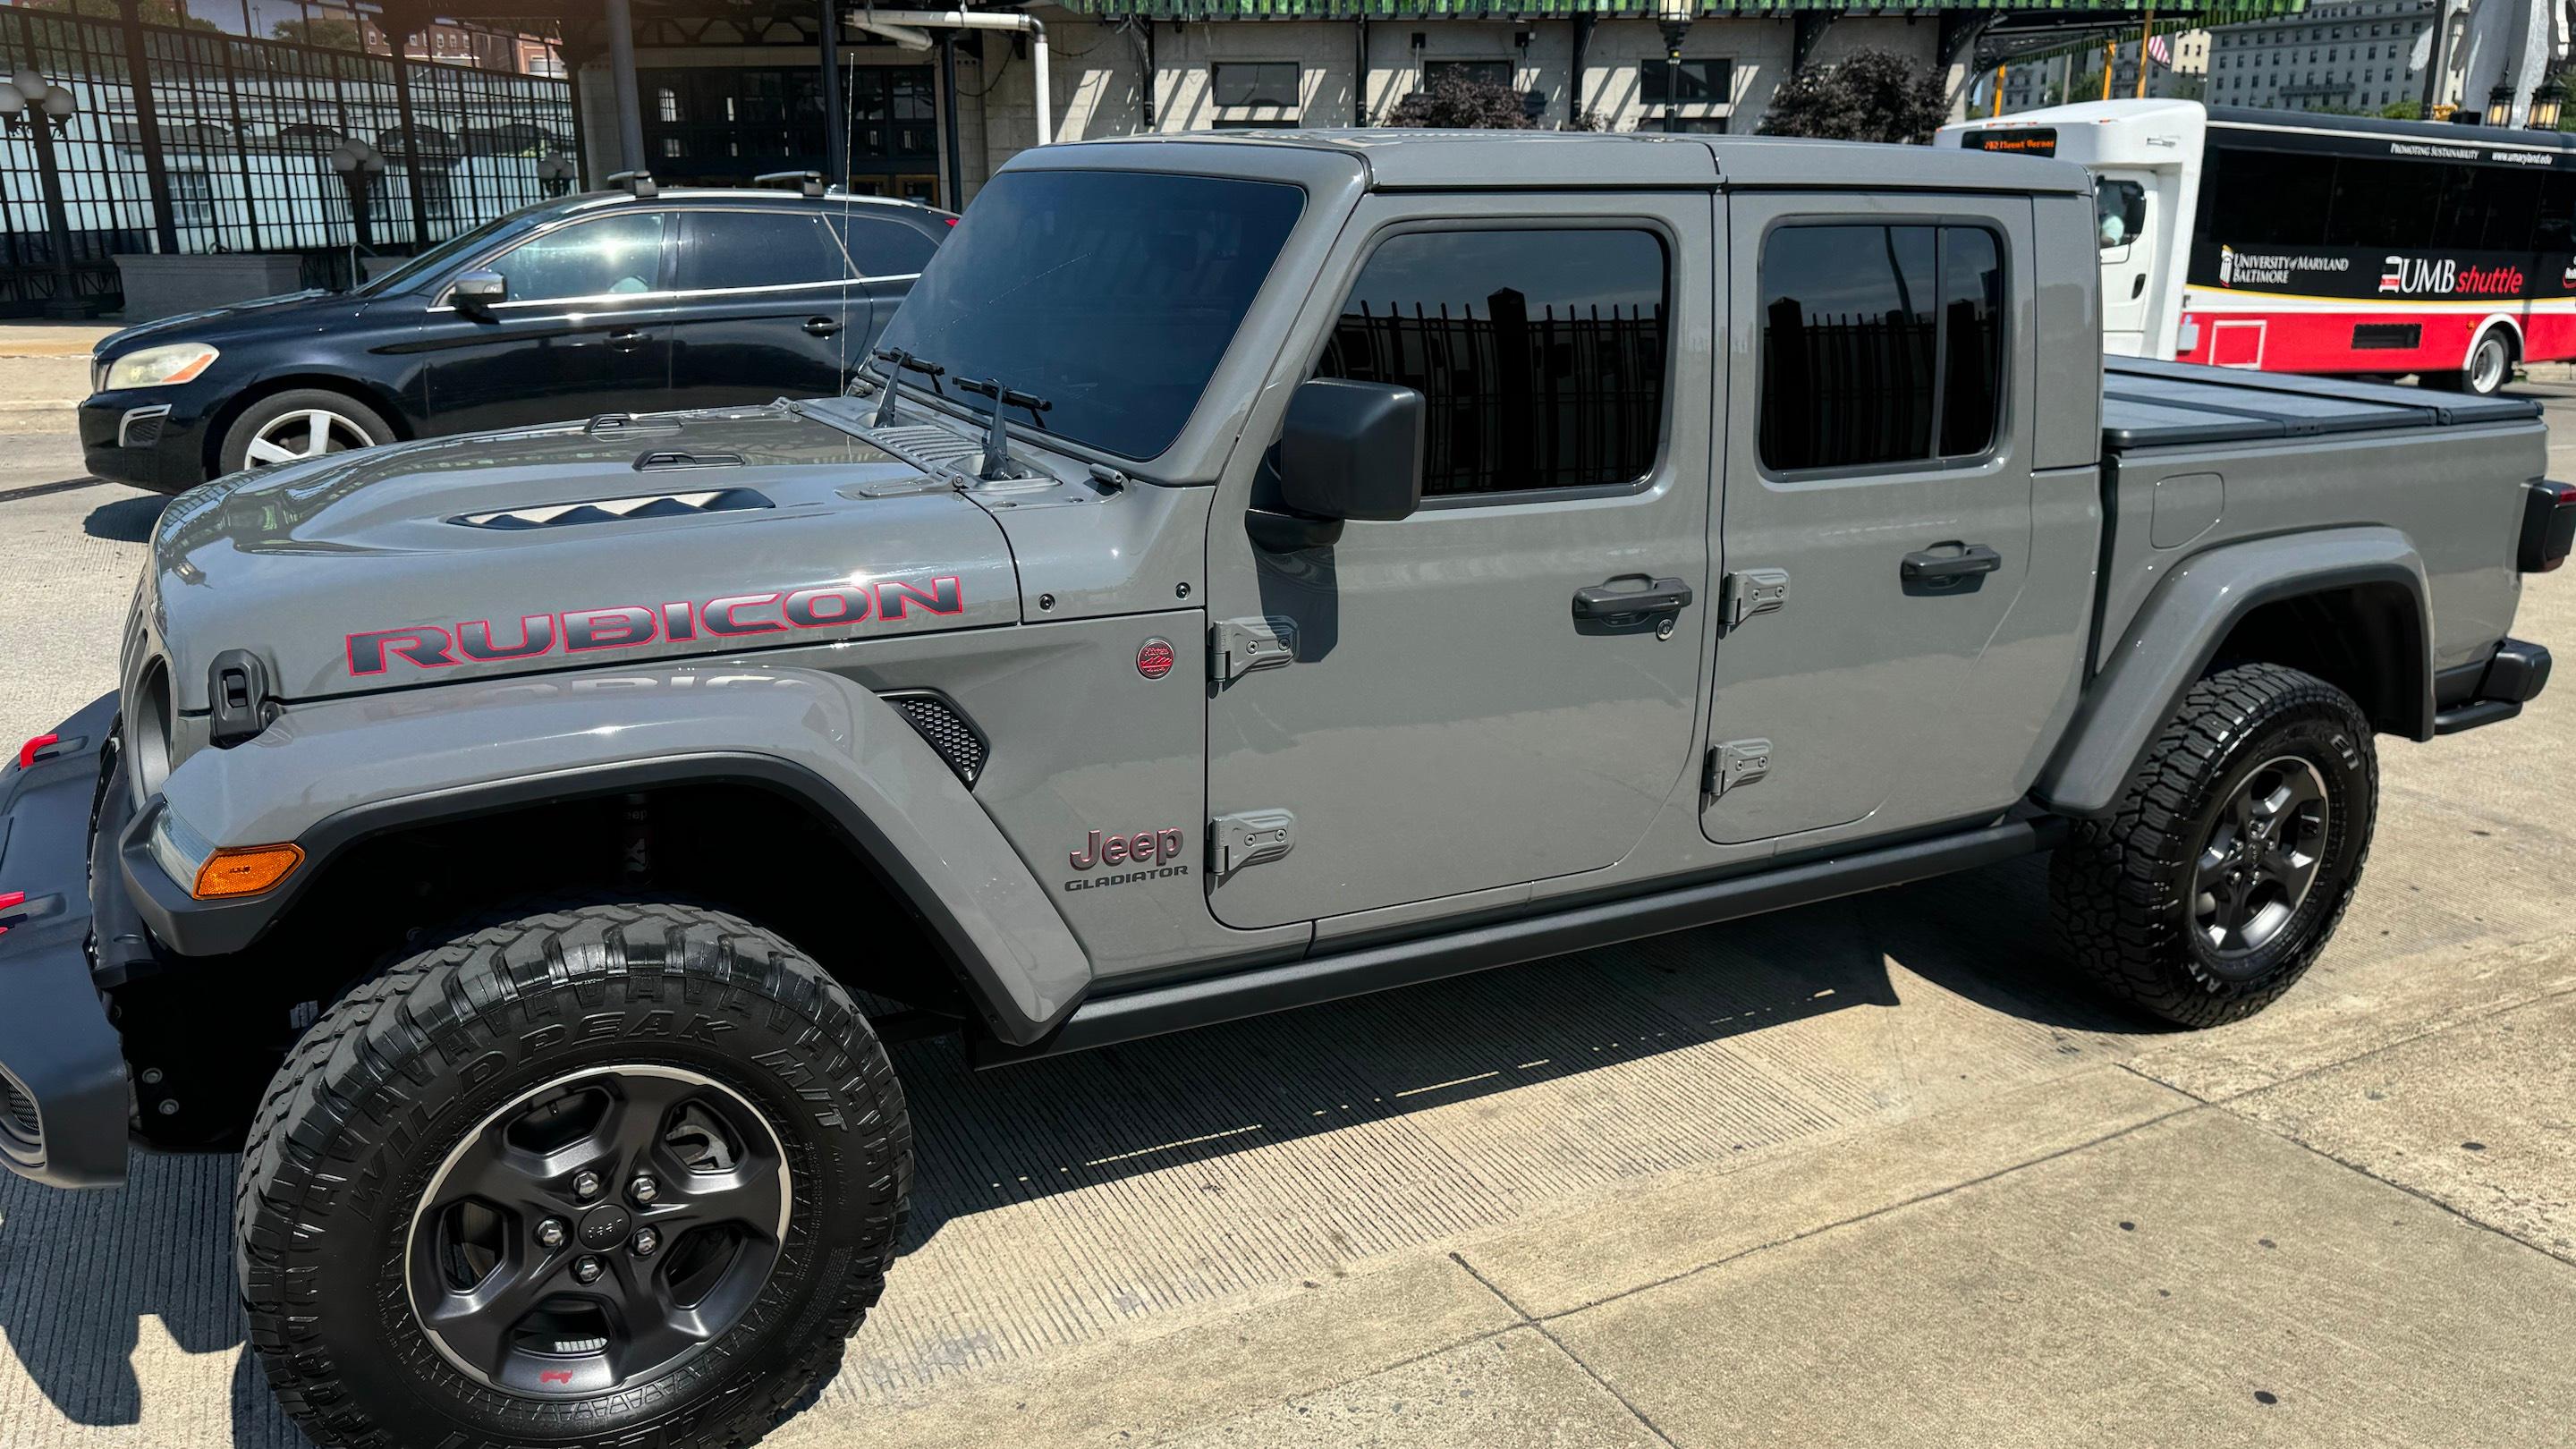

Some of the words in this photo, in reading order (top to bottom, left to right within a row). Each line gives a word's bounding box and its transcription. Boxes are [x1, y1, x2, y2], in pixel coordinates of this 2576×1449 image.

[2390, 143, 2430, 157] PROMOTING
[2430, 146, 2479, 160] SUSTAINABILITY
[2233, 253, 2290, 269] UNIVERSITY
[2298, 256, 2350, 271] MARYLAND
[2233, 269, 2290, 284] BALTIMORE
[2401, 258, 2456, 293] UMB
[2455, 265, 2524, 294] shuttle
[345, 575, 962, 676] RUBICON
[1070, 826, 1183, 871] Jeep
[1064, 865, 1189, 892] GLADIATOR
[347, 1010, 739, 1224] WILDPEAK
